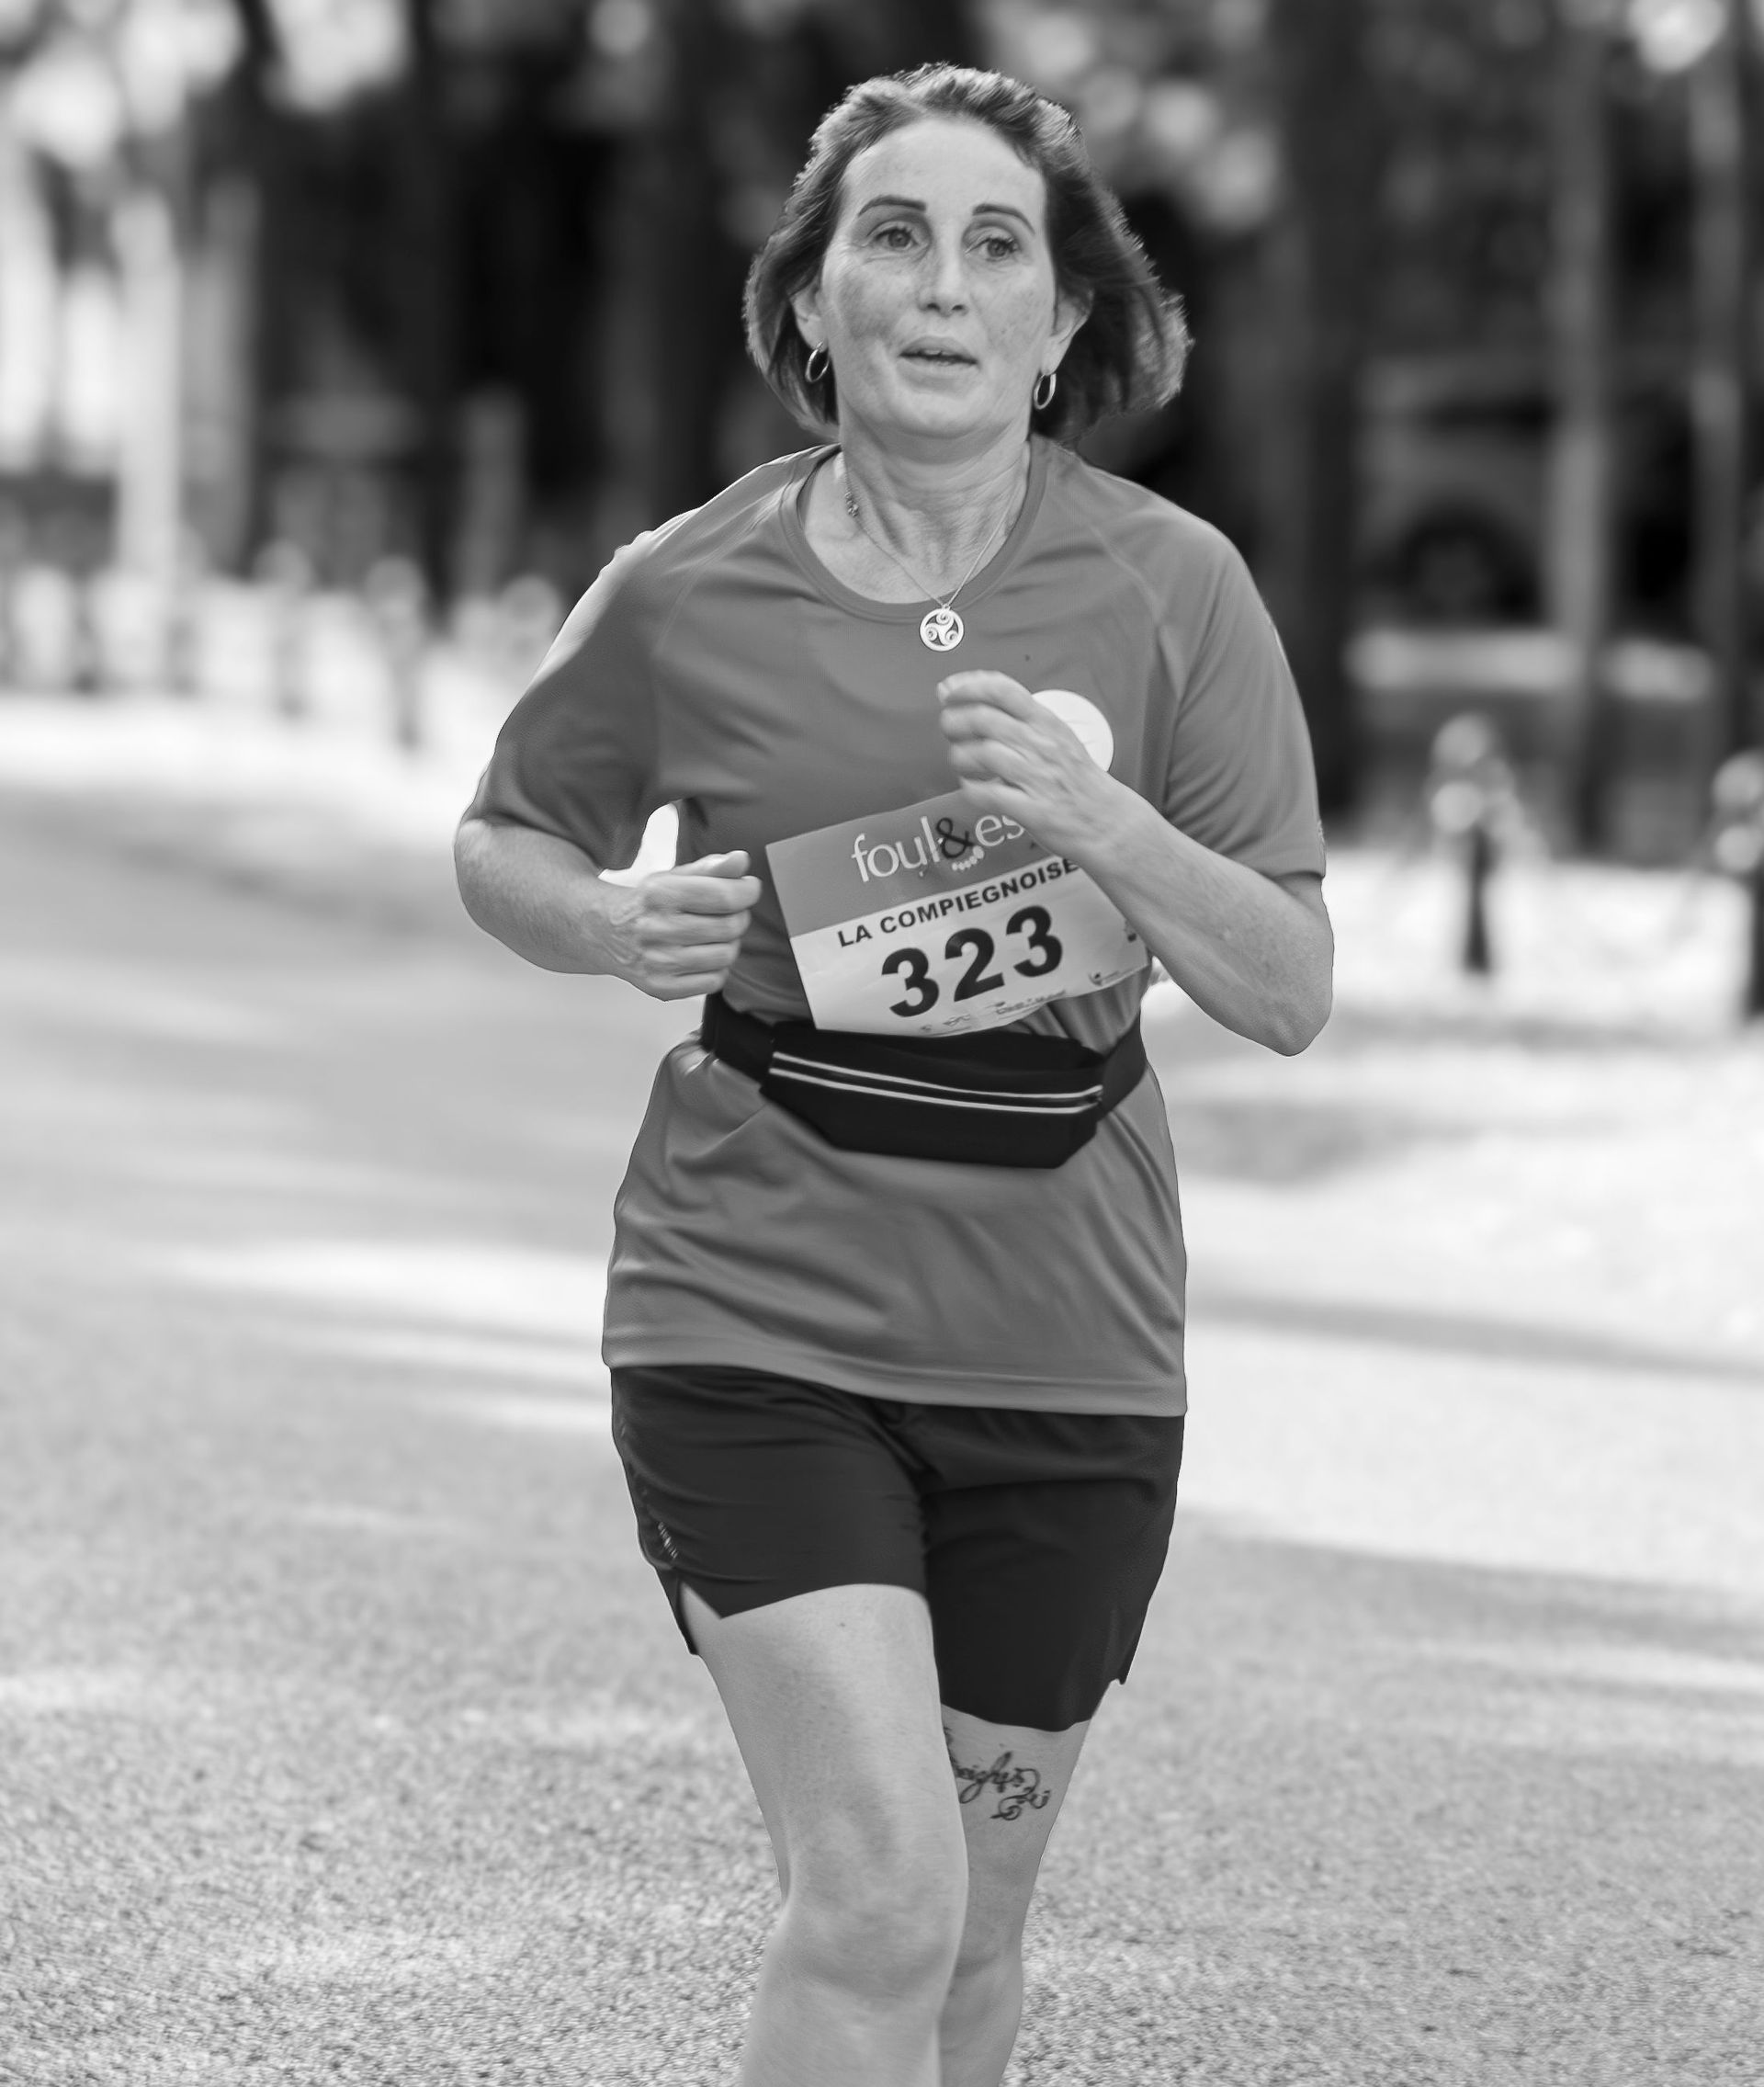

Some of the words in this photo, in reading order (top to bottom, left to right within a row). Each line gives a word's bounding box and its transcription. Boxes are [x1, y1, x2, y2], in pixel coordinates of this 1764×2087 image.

[837, 924, 873, 947] LA
[880, 858, 1080, 934] COMPIEGNOISE
[881, 905, 1062, 1018] 323
